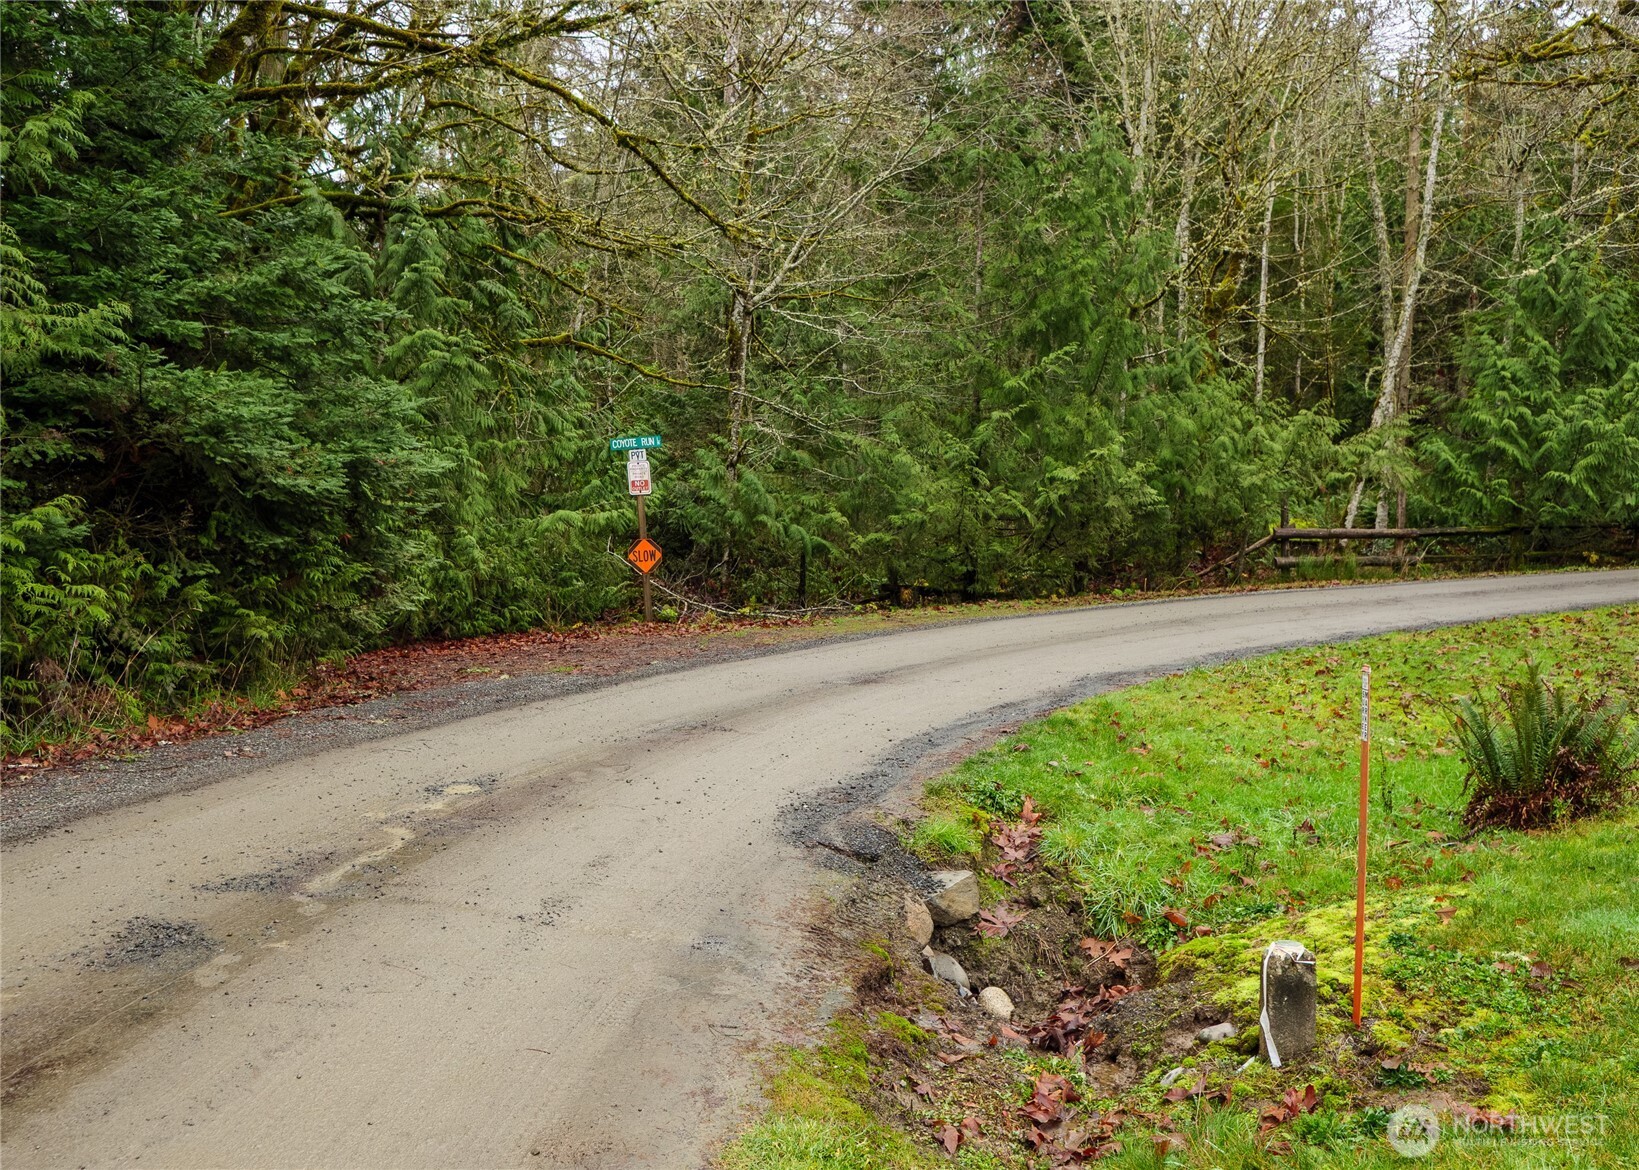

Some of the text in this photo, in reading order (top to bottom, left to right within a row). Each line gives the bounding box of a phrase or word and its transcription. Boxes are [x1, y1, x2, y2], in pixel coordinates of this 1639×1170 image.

[612, 438, 638, 448] COYOTE
[640, 437, 654, 446] RUN
[631, 451, 644, 460] PVT
[632, 550, 656, 562] SLOW
